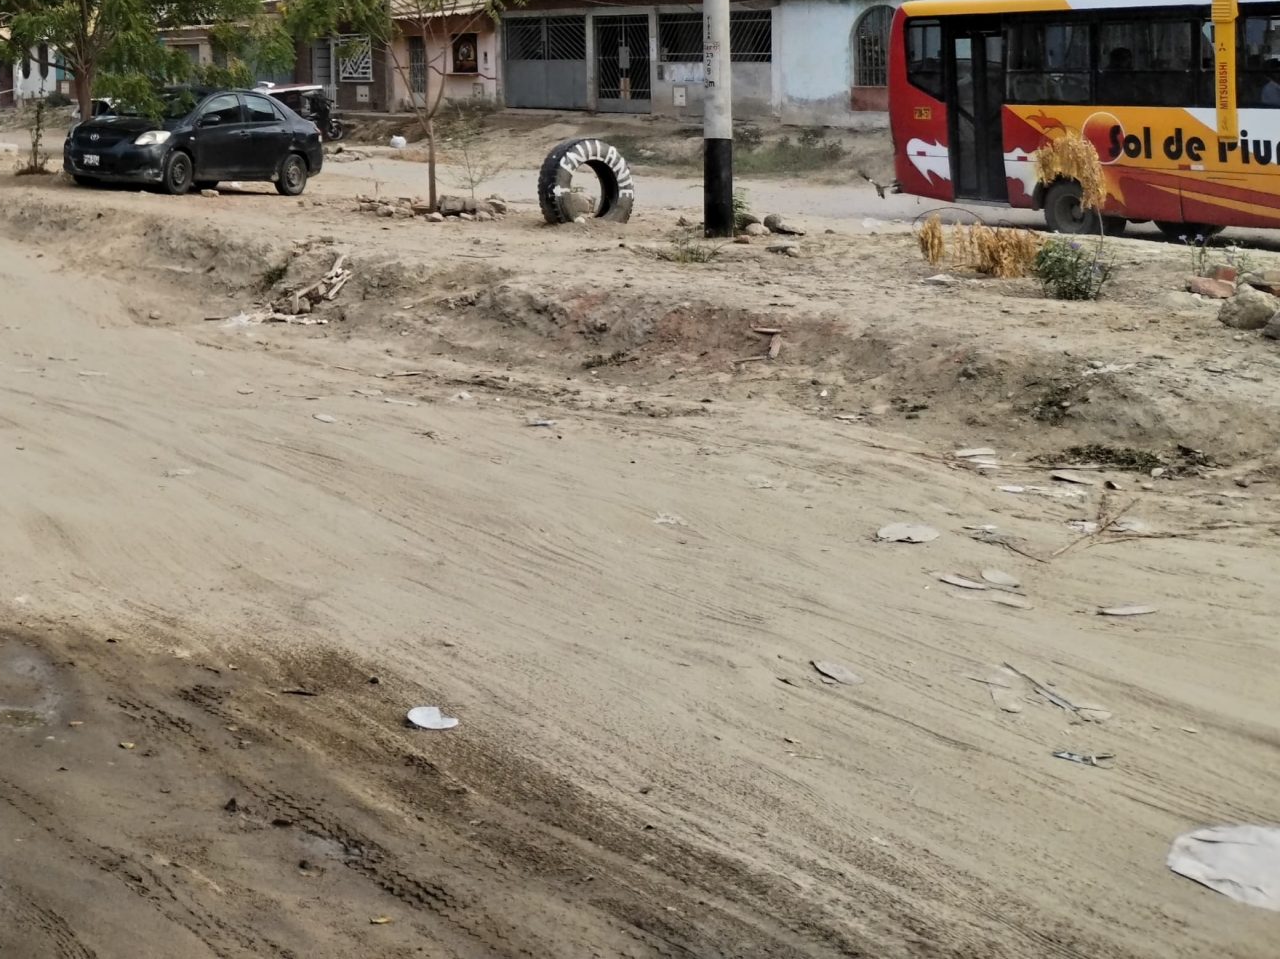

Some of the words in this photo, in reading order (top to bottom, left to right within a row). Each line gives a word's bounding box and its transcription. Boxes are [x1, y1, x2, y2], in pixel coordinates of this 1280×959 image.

[1219, 62, 1228, 109] MITSUBISHI
[1109, 125, 1152, 159] Sol
[1163, 128, 1206, 162] de
[1217, 129, 1280, 166] Piu
